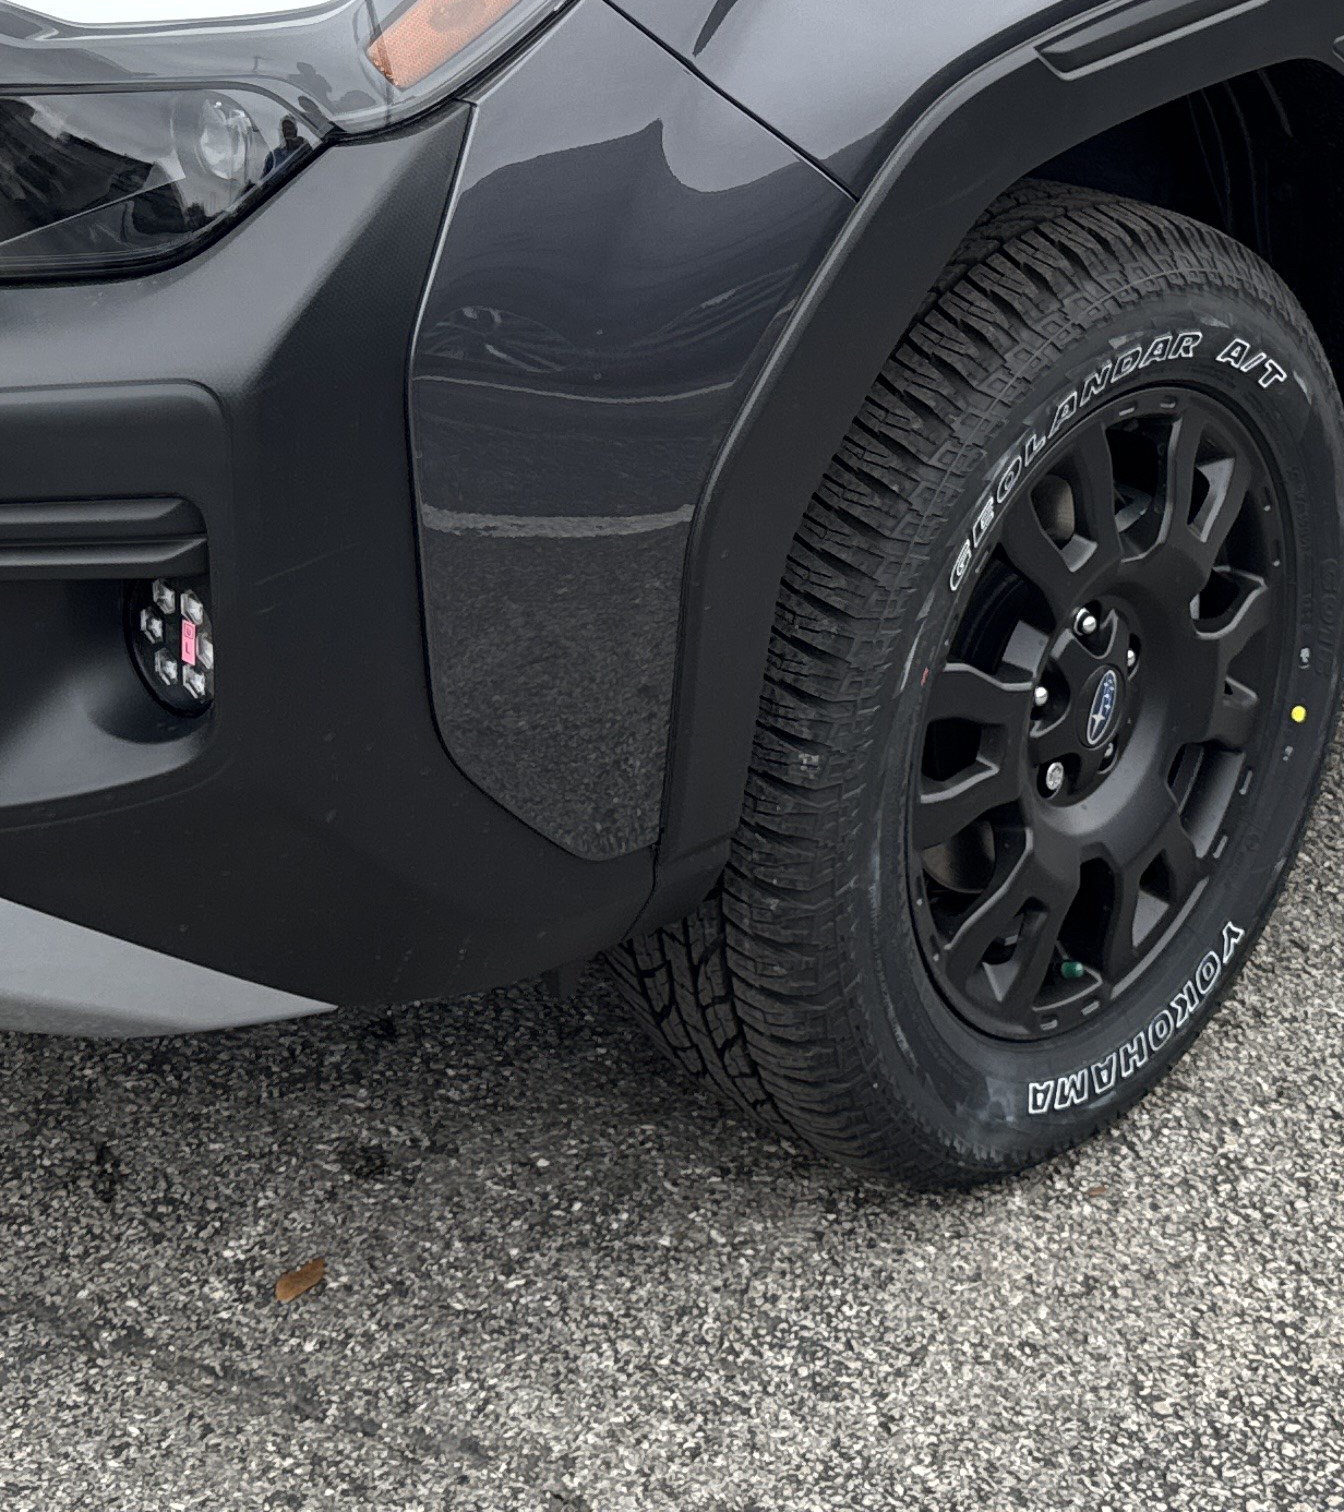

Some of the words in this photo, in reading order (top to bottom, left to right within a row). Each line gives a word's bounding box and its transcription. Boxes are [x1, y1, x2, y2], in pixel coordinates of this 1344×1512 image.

[950, 331, 1203, 591] GEOLANDAR
[1216, 338, 1288, 388] A/T
[1028, 921, 1245, 1114] YOKOHAMA
